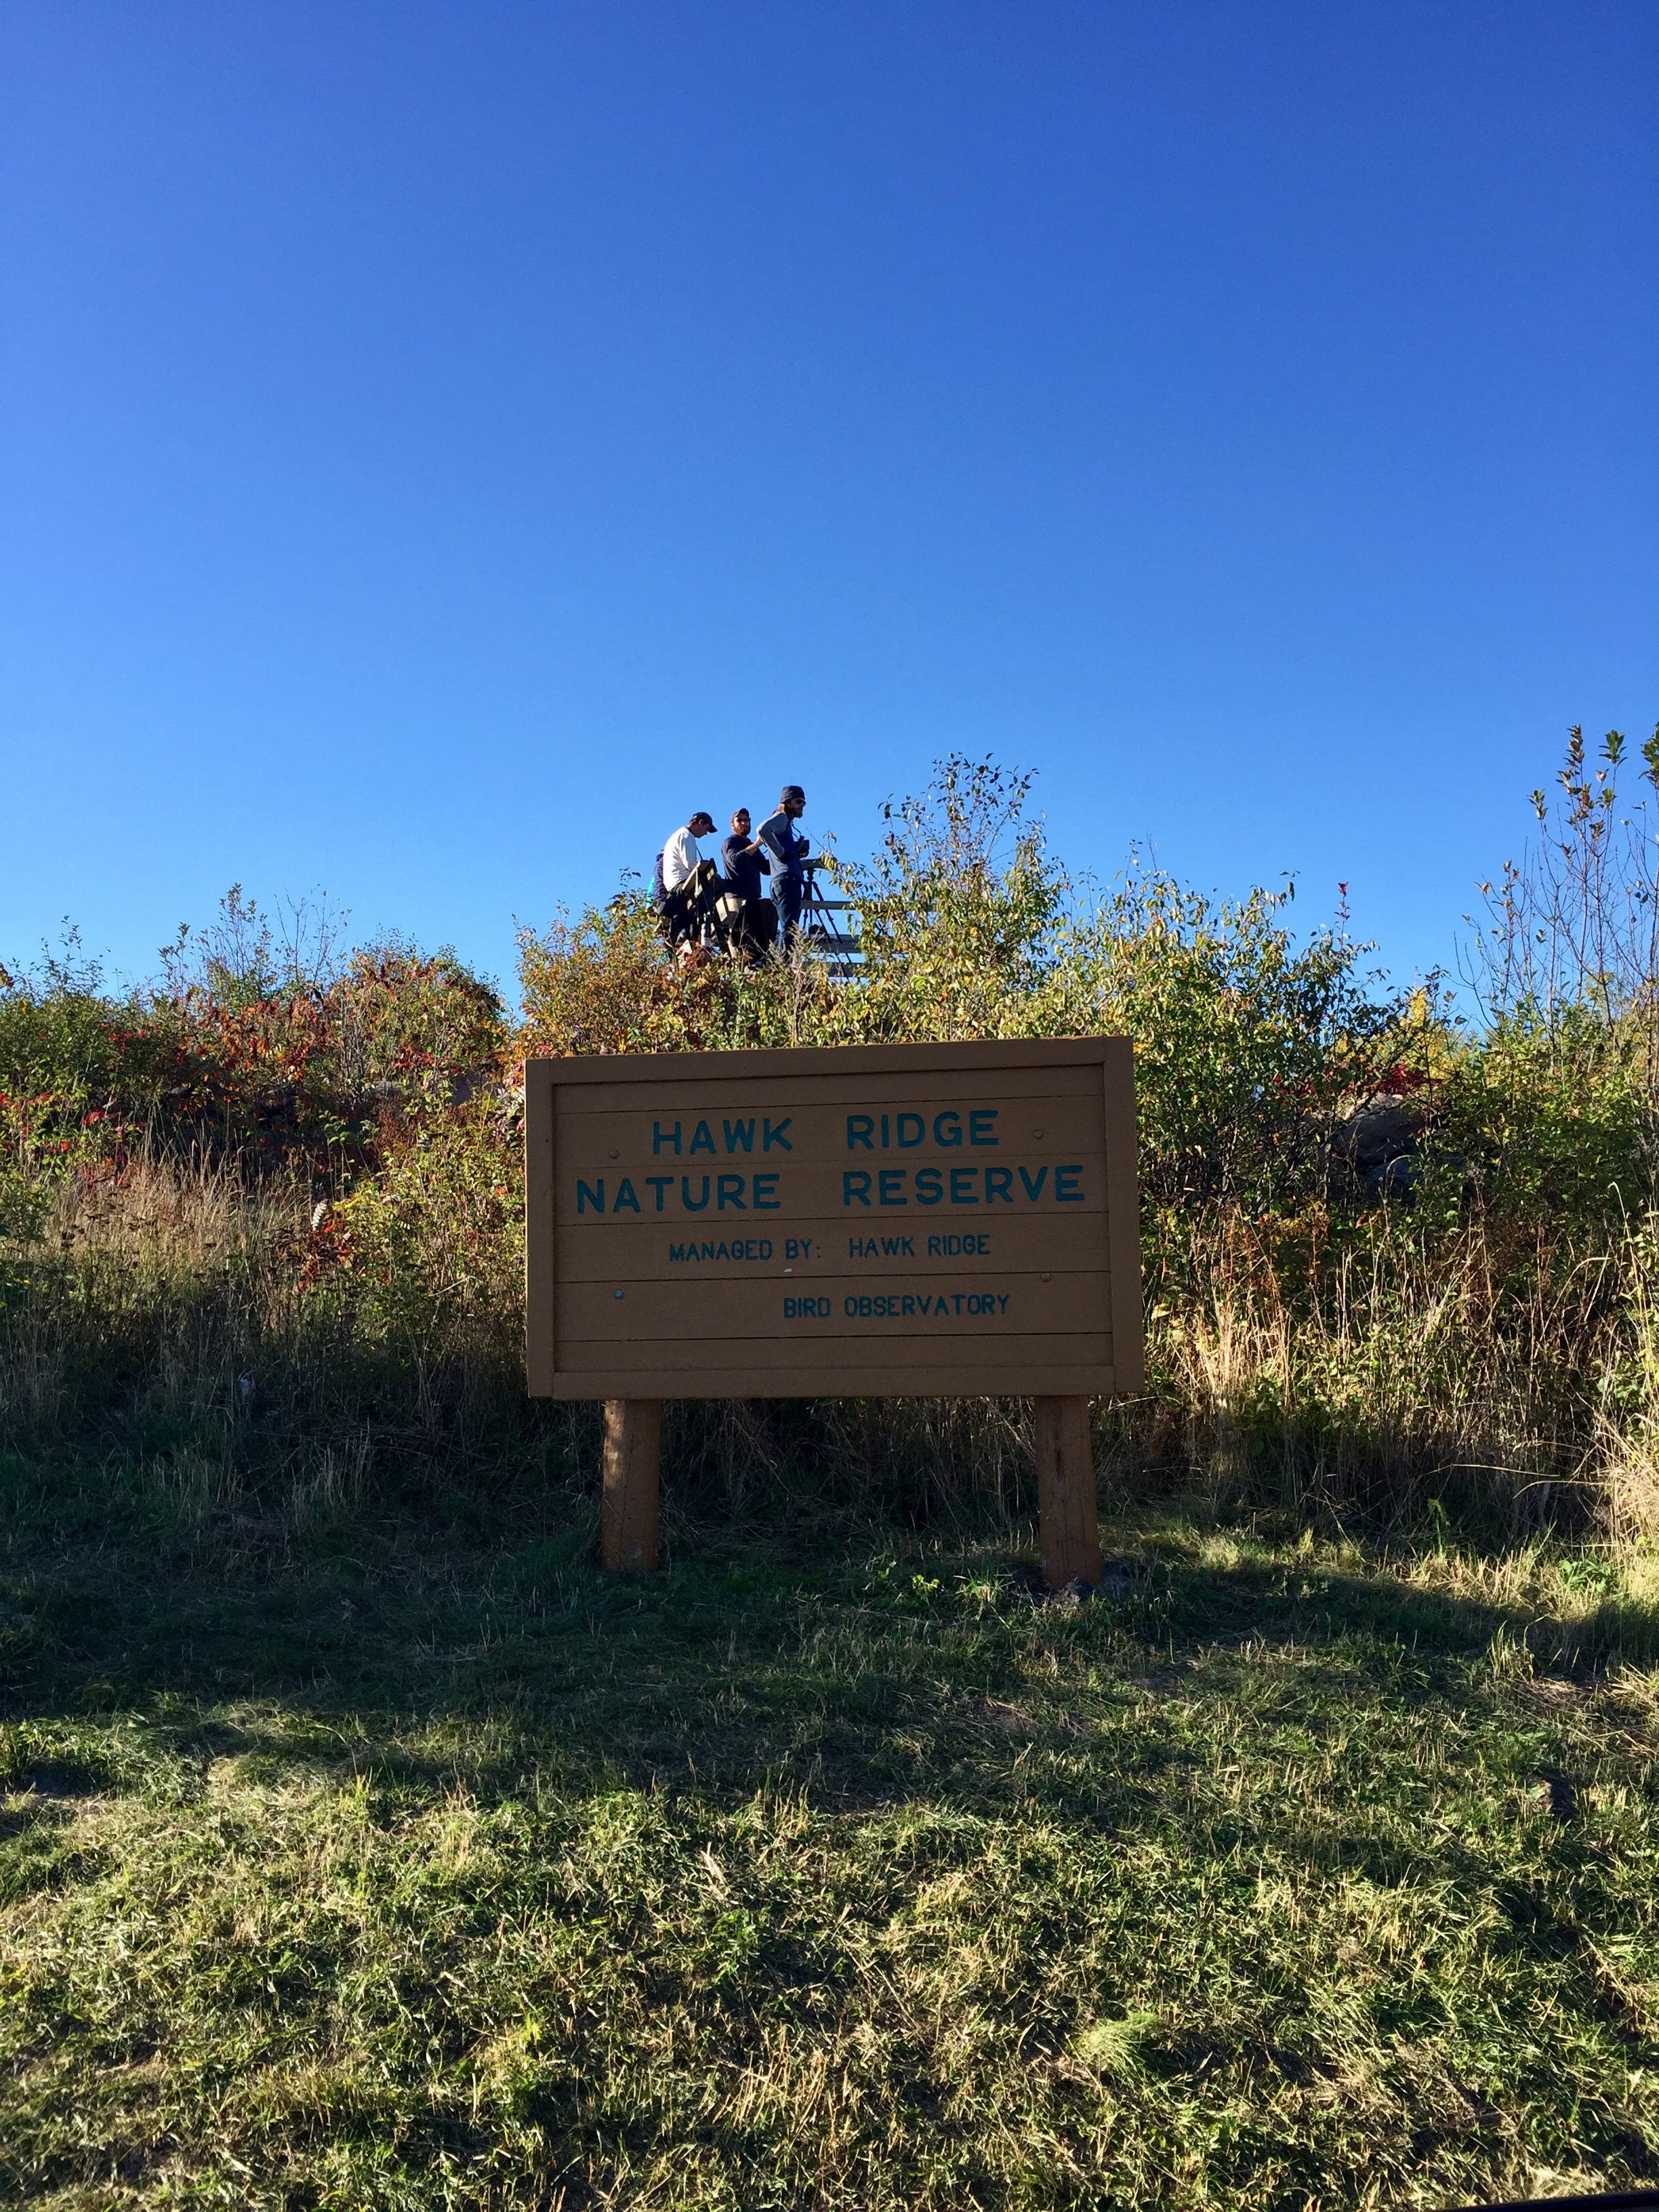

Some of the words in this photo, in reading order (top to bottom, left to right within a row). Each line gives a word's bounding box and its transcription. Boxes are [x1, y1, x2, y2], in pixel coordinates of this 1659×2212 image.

[652, 1118, 794, 1155] HAWK
[846, 1109, 1000, 1150] RIDGE
[576, 1173, 781, 1214] NATURE
[842, 1164, 1085, 1207] RESERVE
[669, 1240, 773, 1261] MANAGED
[849, 1237, 914, 1258] HAWK
[927, 1233, 991, 1256] RIDGE
[783, 1297, 832, 1319] BIRD
[844, 1293, 1009, 1317] OBSERVATORY
